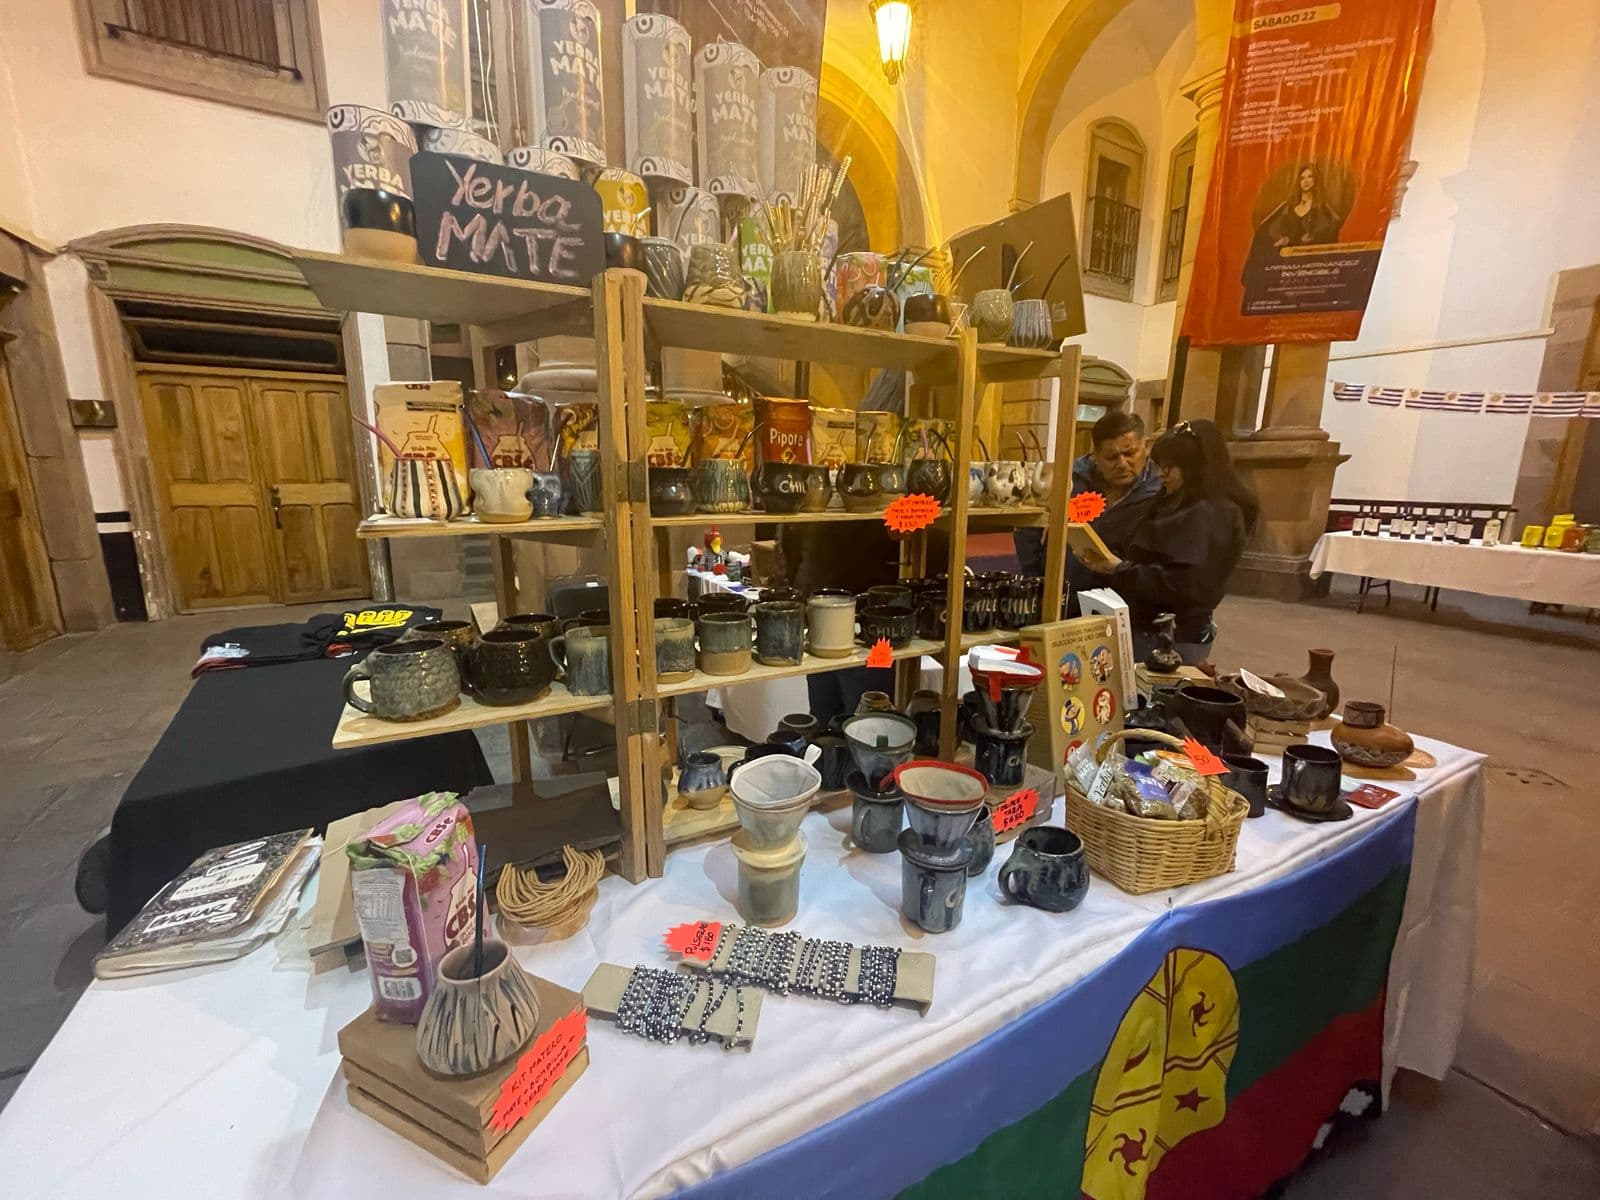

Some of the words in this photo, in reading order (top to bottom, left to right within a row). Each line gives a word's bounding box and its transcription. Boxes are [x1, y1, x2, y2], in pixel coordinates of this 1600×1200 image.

[342, 164, 404, 193] YERBA
[445, 160, 582, 231] Yerba
[435, 211, 585, 278] MATE
[511, 1070, 526, 1094] KIT
[529, 1034, 562, 1075] MATERO
